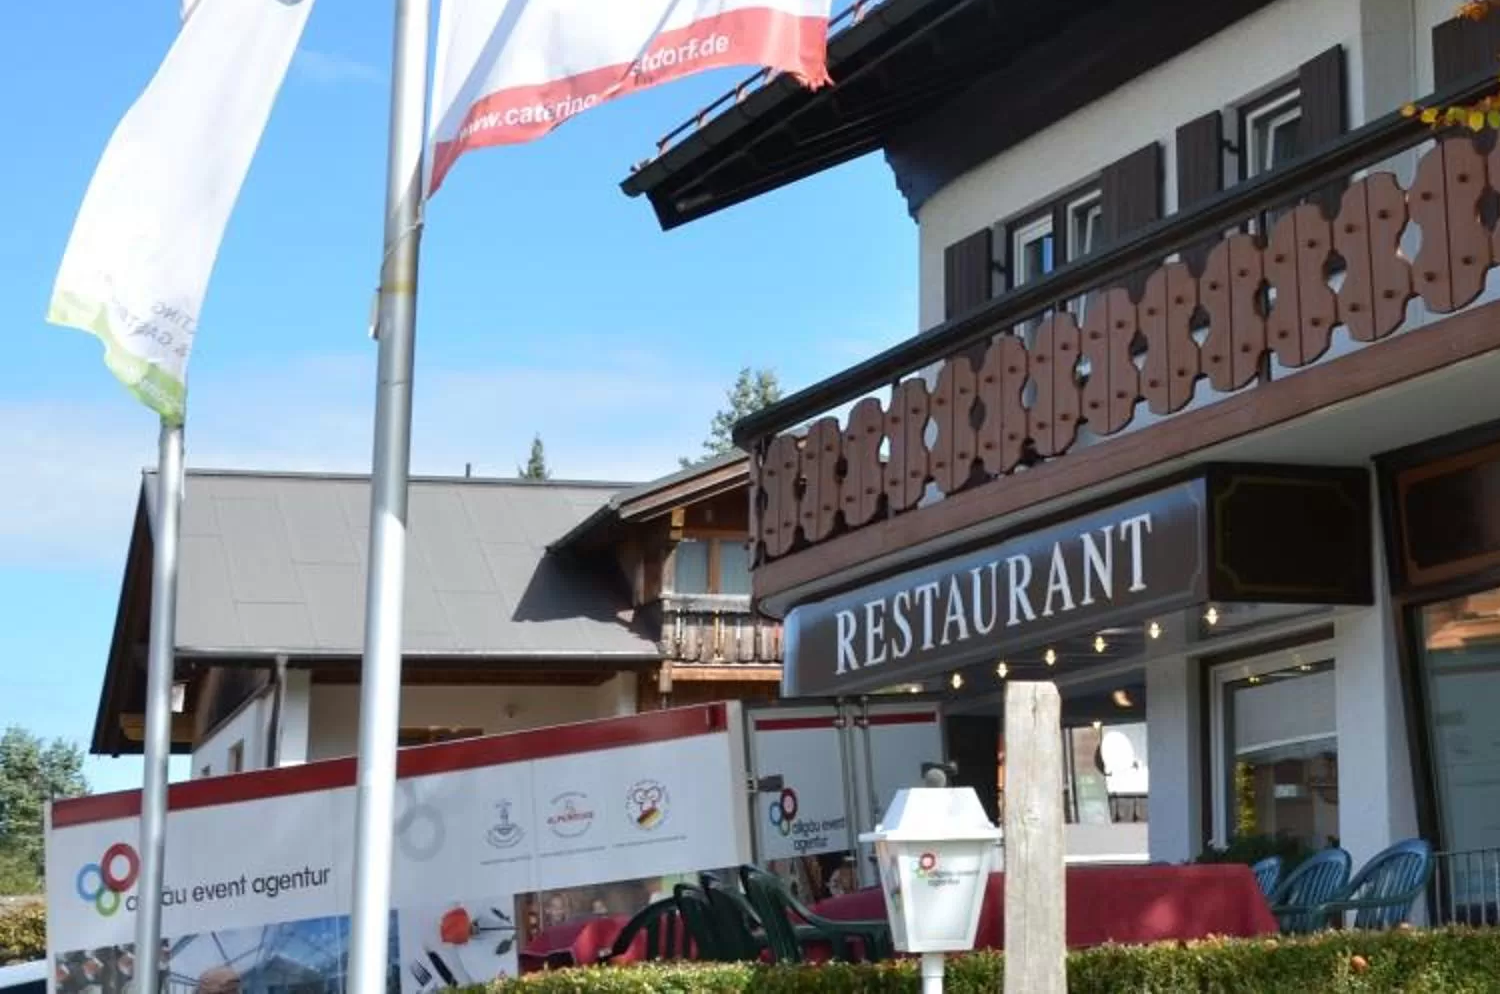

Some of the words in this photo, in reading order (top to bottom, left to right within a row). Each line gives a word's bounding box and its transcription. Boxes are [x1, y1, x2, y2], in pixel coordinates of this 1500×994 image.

[833, 513, 1153, 675] RESTAURANT
[192, 874, 247, 902] event
[251, 865, 331, 899] agentur
